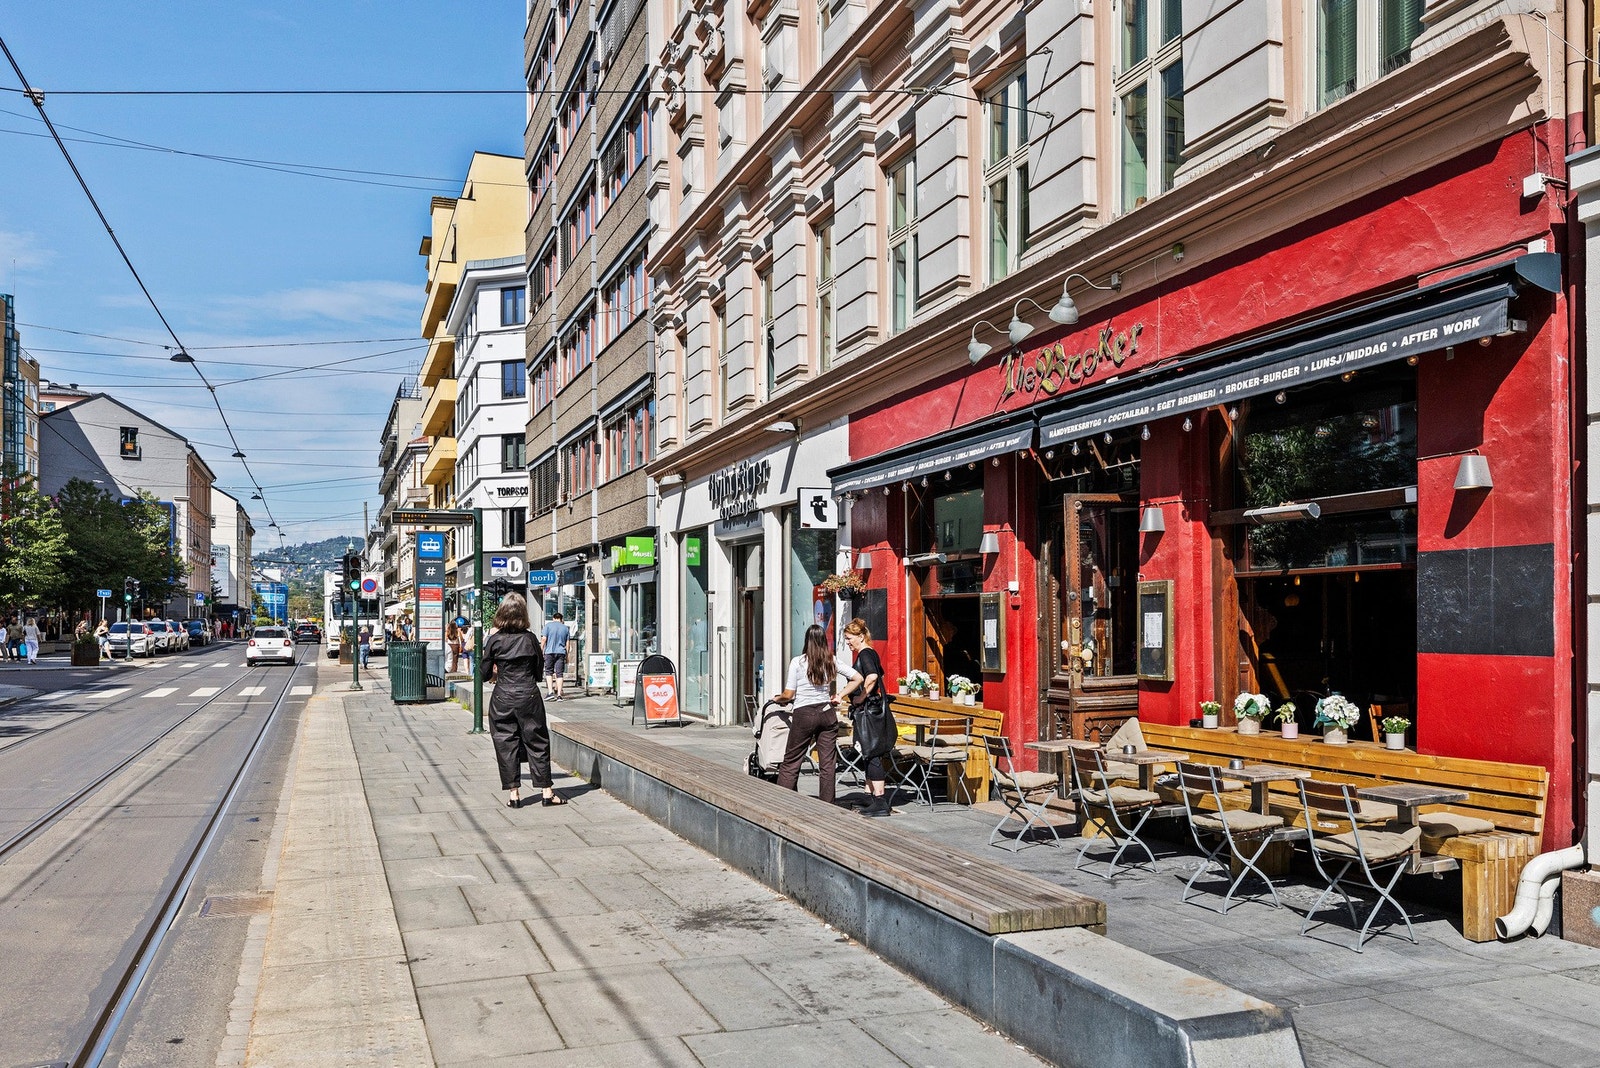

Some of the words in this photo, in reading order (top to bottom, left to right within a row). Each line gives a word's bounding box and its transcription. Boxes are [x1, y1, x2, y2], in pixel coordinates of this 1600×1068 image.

[998, 344, 1036, 398] The
[1036, 322, 1144, 393] Broker
[1049, 418, 1102, 438] HÅNDVERKSBRYGG
[1108, 406, 1149, 423] COCTAILBAR
[1156, 398, 1176, 412] EGET
[1178, 389, 1216, 406] BRENNERI
[1225, 366, 1300, 394] BROKER-BURGER
[1311, 342, 1388, 371] LUNSJ/MIDDAG
[1400, 328, 1438, 347] AFTER
[1443, 316, 1481, 336] WORK
[989, 441, 1005, 450] AFTER
[531, 573, 554, 581] norli
